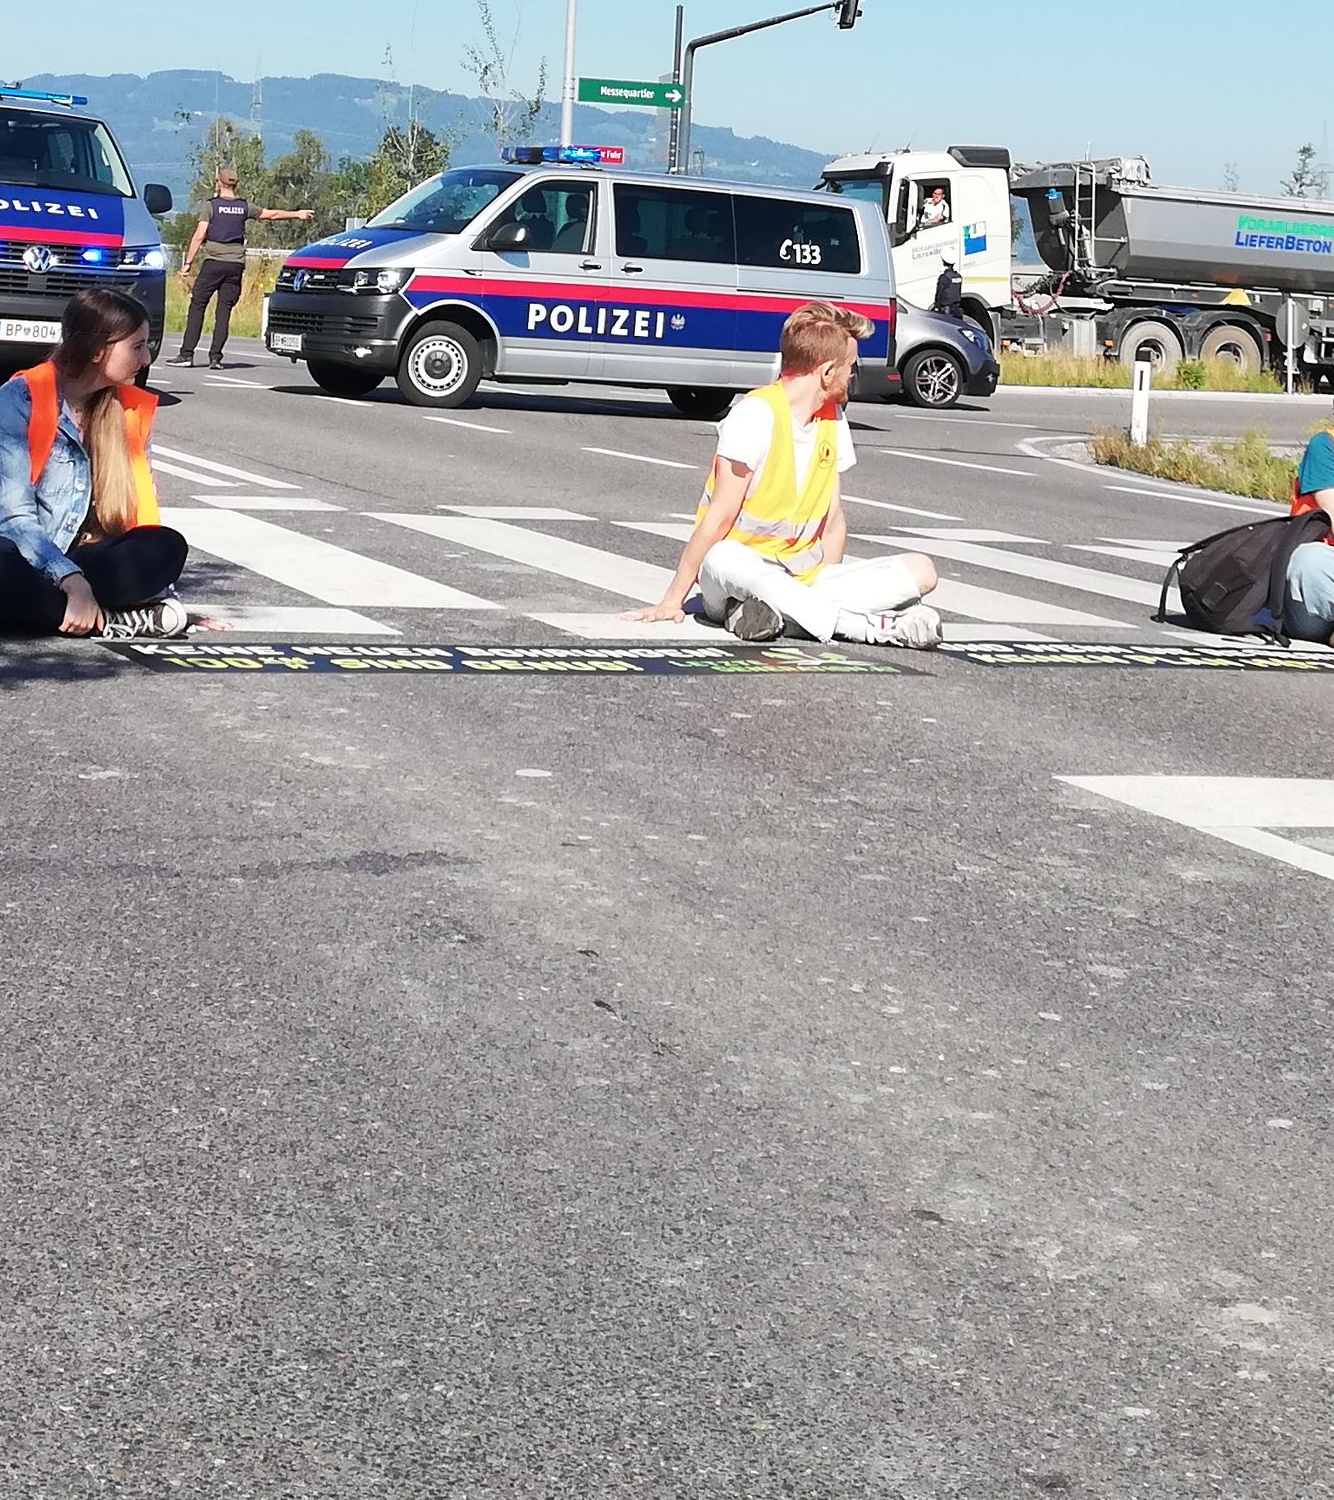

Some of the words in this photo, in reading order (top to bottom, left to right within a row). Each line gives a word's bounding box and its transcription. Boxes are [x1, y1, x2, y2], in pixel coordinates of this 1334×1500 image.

[600, 86, 655, 99] Messequartier
[218, 206, 244, 215] POLIZEI
[793, 242, 822, 265] 133
[527, 303, 665, 338] POLIZEI
[130, 645, 285, 656] KEINE
[290, 646, 453, 657] NEUEN
[455, 646, 735, 658] BOHRUNGEN!
[329, 658, 453, 670] SIND
[462, 660, 645, 671] GENUG!
